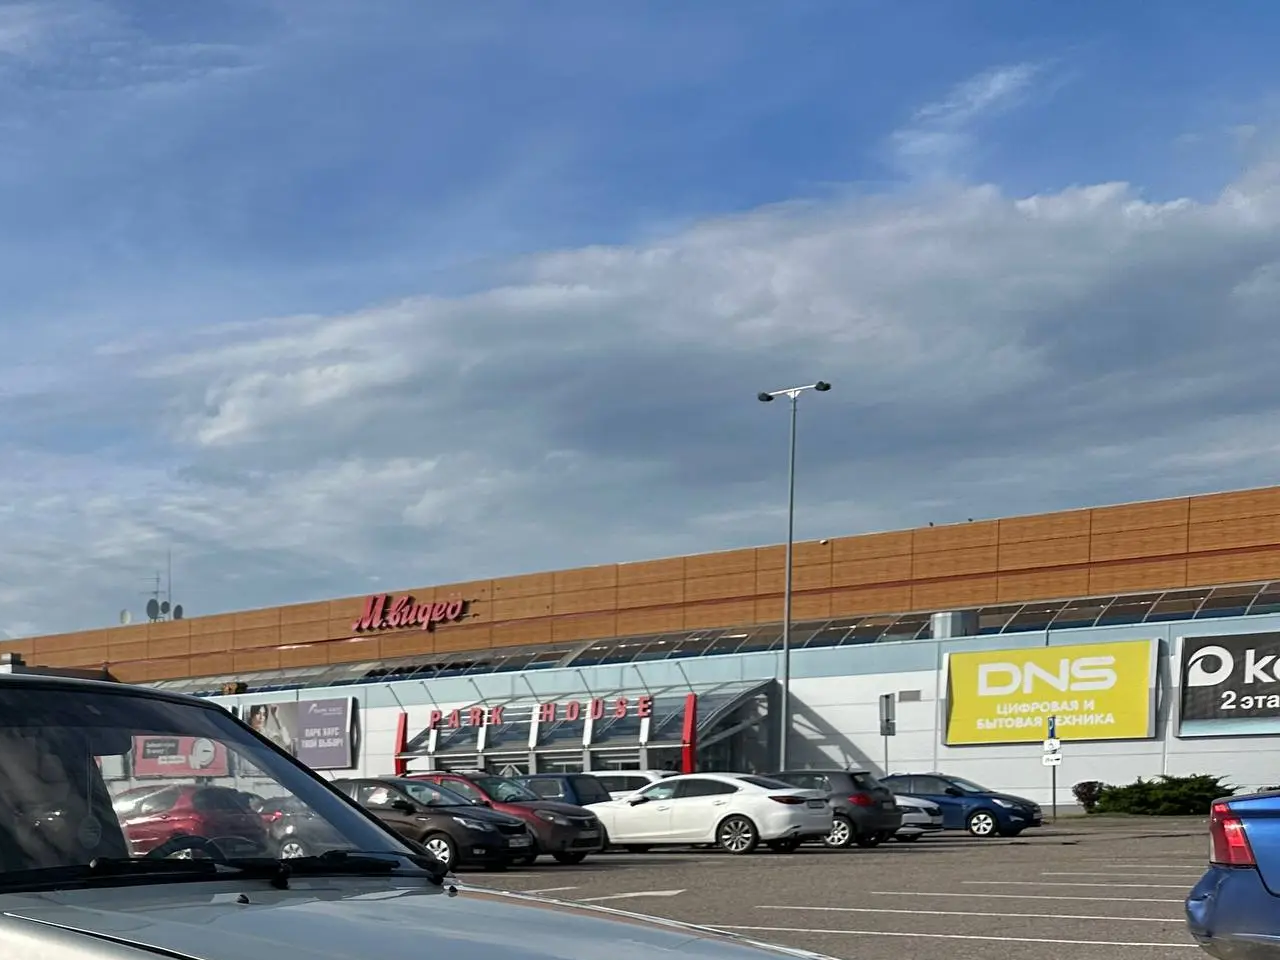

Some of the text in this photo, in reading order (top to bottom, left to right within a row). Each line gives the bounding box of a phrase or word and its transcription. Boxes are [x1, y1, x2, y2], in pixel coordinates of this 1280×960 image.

[352, 593, 463, 631] М.видео
[977, 655, 1118, 697] DNS
[1243, 648, 1280, 684] k
[429, 695, 654, 730] PARK HOUSE
[996, 699, 1095, 715] ЦИФРОВАЯ И
[1220, 690, 1237, 710] 2
[976, 712, 1115, 730] БЫТОВАЯ ЕХНИКА
